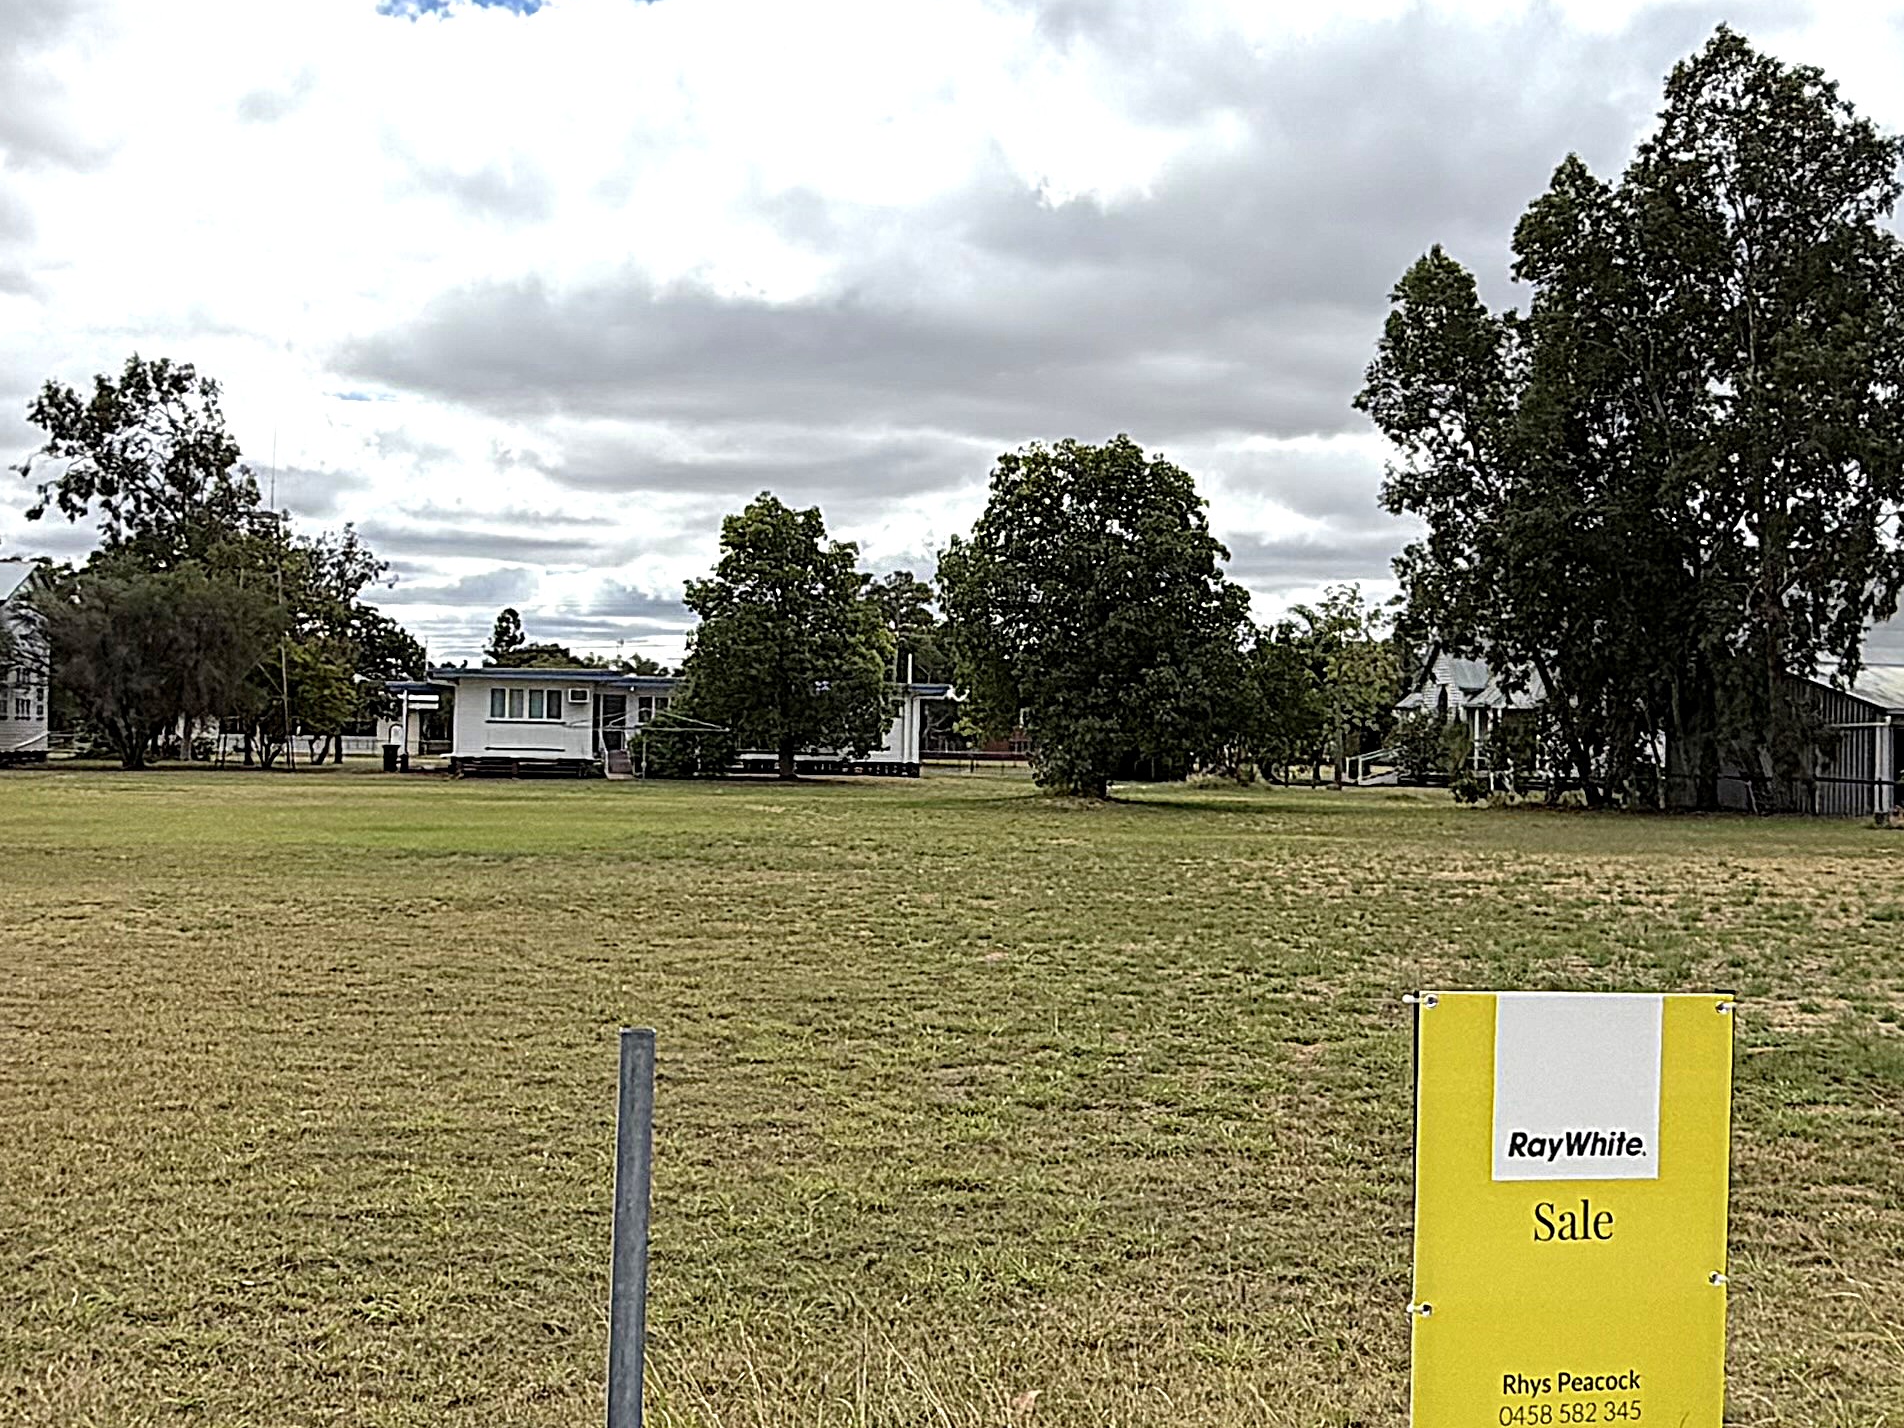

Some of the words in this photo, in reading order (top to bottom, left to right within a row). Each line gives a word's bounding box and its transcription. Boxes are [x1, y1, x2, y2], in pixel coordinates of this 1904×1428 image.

[1534, 1198, 1614, 1242] Sale
[1503, 1373, 1551, 1398] Rhys
[1558, 1369, 1641, 1393] Peacock
[1499, 1405, 1552, 1426] 0458
[1559, 1402, 1597, 1424] 582
[1603, 1400, 1641, 1421] 345
